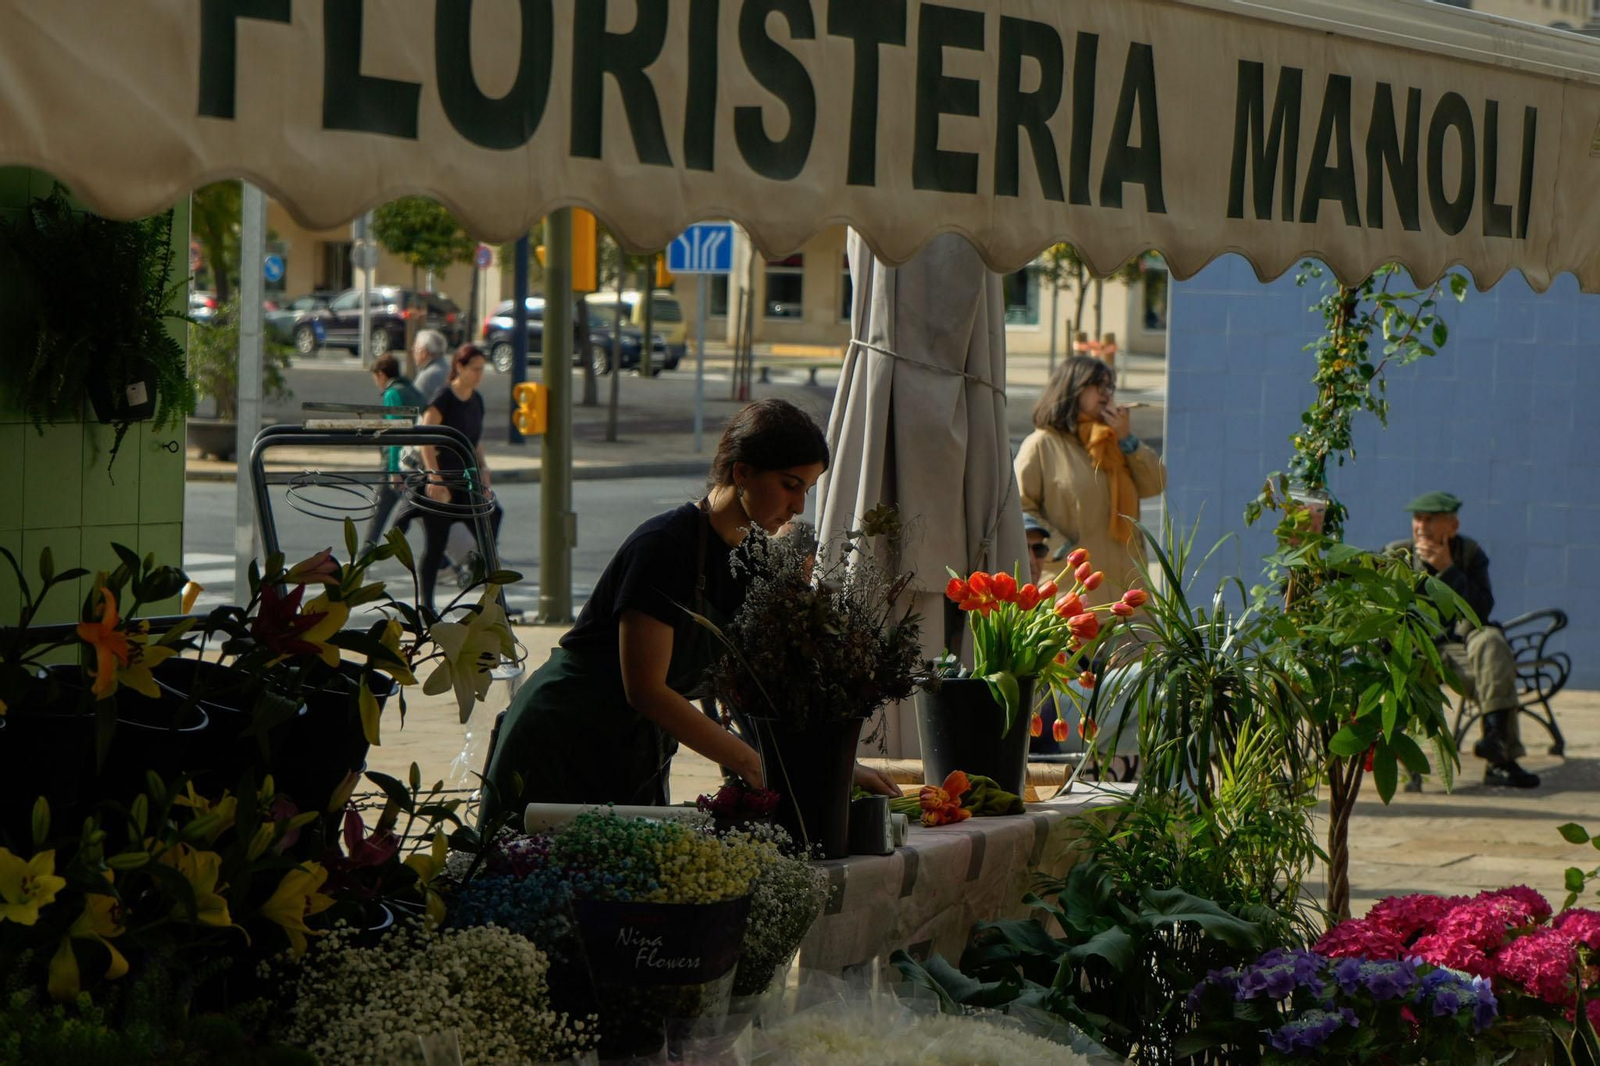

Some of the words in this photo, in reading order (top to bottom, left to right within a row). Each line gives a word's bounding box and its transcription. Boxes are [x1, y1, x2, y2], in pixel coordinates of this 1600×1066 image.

[1227, 59, 1537, 239] MANOLI
[615, 926, 664, 947] Nina
[634, 947, 701, 969] Flowers
